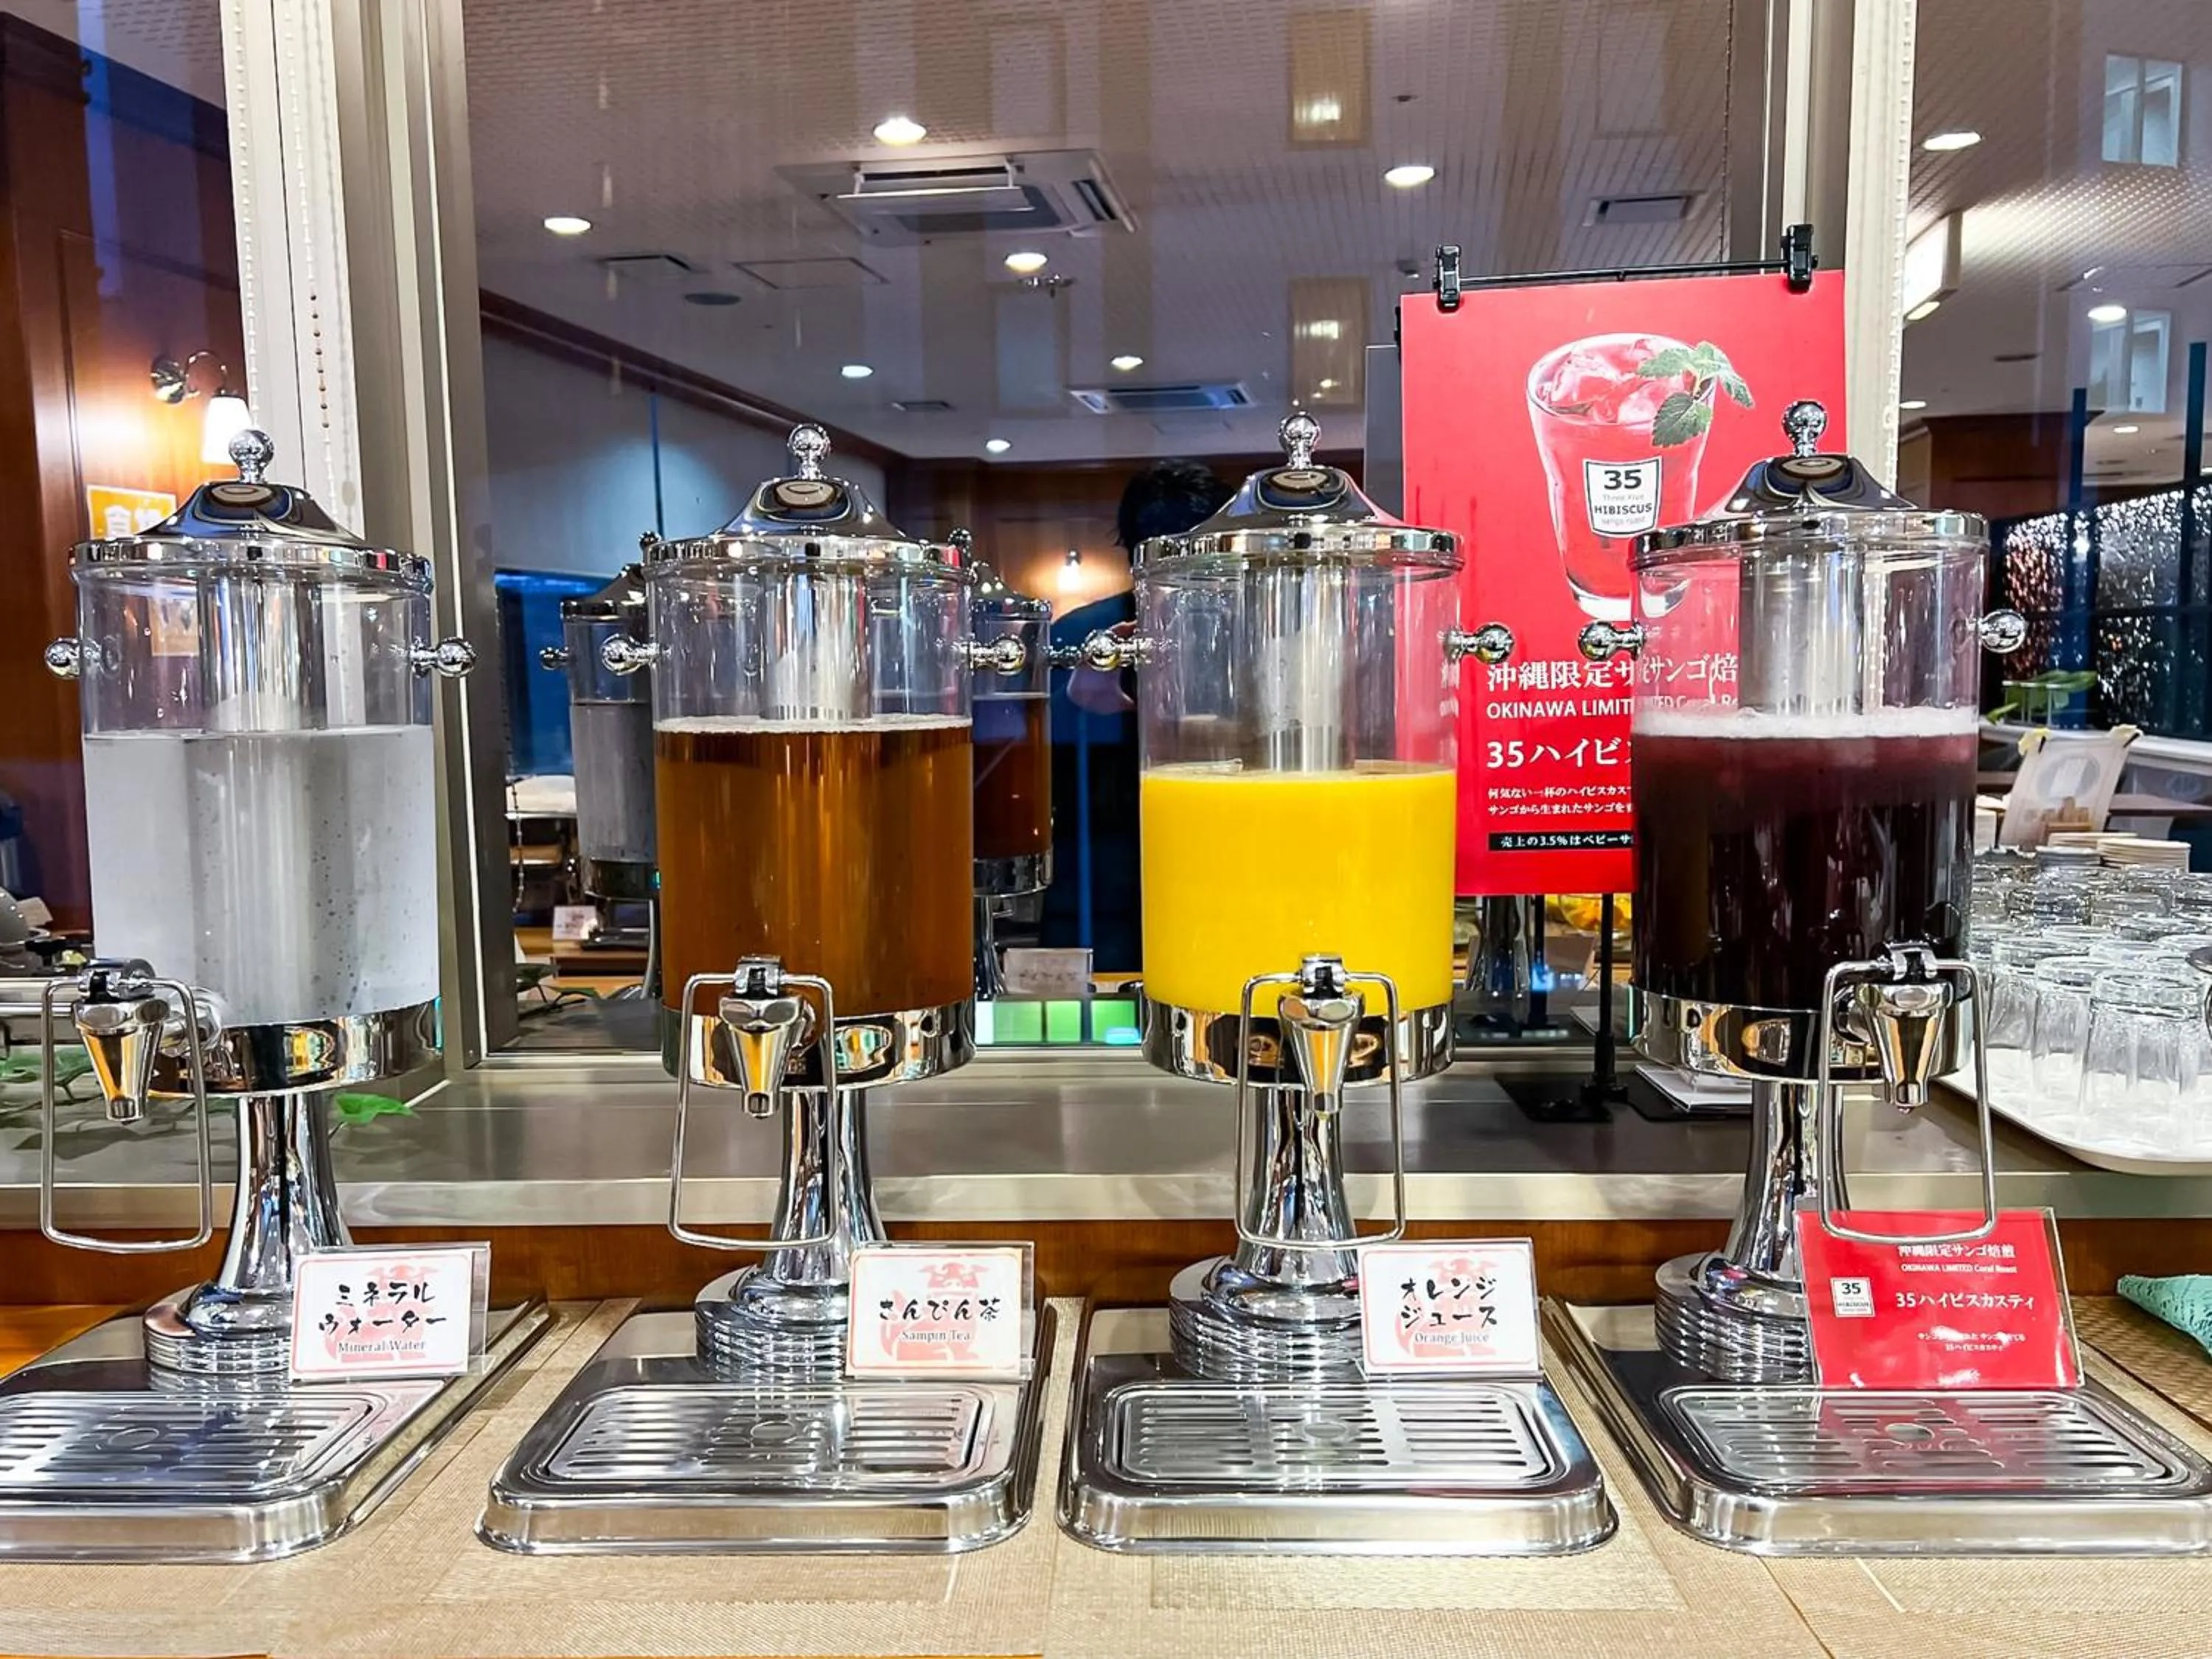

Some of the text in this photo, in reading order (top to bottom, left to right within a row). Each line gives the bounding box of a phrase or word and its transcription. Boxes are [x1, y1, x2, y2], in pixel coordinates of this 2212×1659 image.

[1604, 468, 1642, 490] 35
[1594, 502, 1652, 515] HIBISCUS
[1486, 700, 1576, 719] OKINAWA
[1486, 737, 1632, 768] 35ハイビ
[335, 1281, 435, 1307] ミネラル
[1400, 1276, 1498, 1301] オレンジ
[1841, 1282, 1861, 1295] 35
[879, 1298, 1001, 1322] さんぴん茶
[1400, 1304, 1498, 1329] ジュース
[319, 1310, 447, 1335] ウォーター
[338, 1340, 427, 1352] Mineral Water
[902, 1330, 970, 1343] Sampin Tea
[1415, 1332, 1489, 1345] Orange Juice
